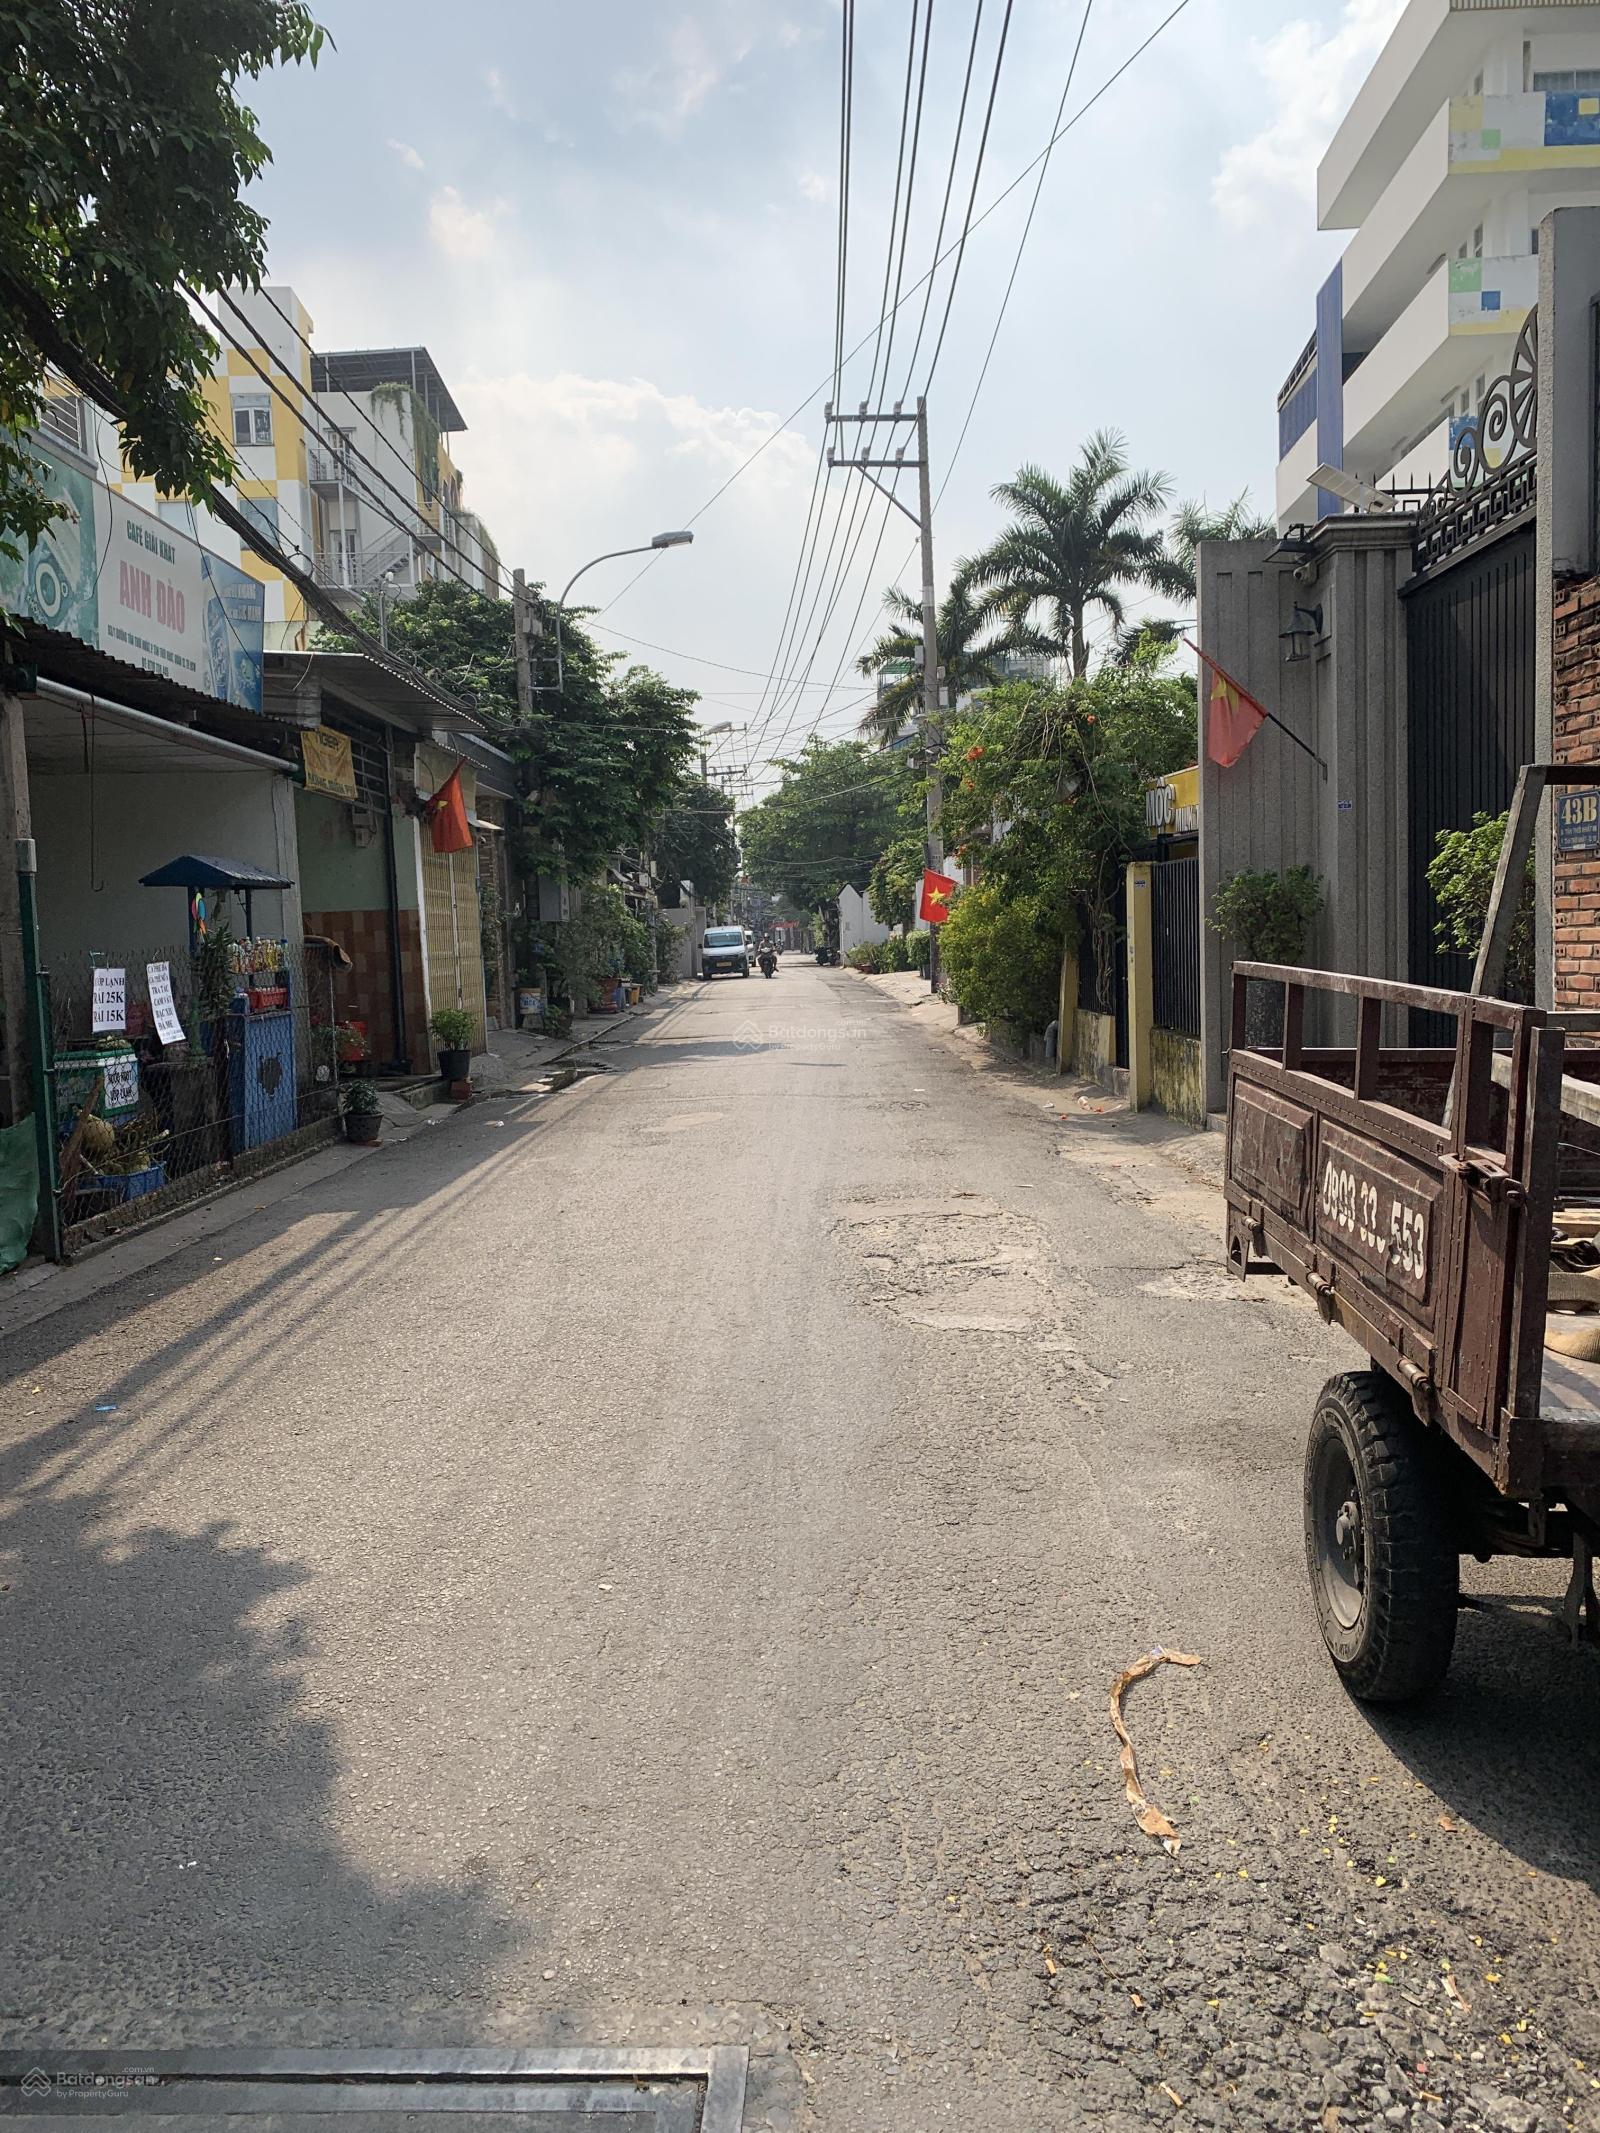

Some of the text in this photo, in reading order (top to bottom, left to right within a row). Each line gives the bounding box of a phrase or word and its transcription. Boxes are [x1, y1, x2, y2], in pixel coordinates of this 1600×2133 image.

[120, 560, 151, 618] ANH
[1562, 796, 1597, 825] 43B
[105, 977, 125, 988] LẠNH
[106, 992, 124, 1004] 25K
[106, 1009, 124, 1022] 15K
[1391, 1200, 1424, 1280] 553
